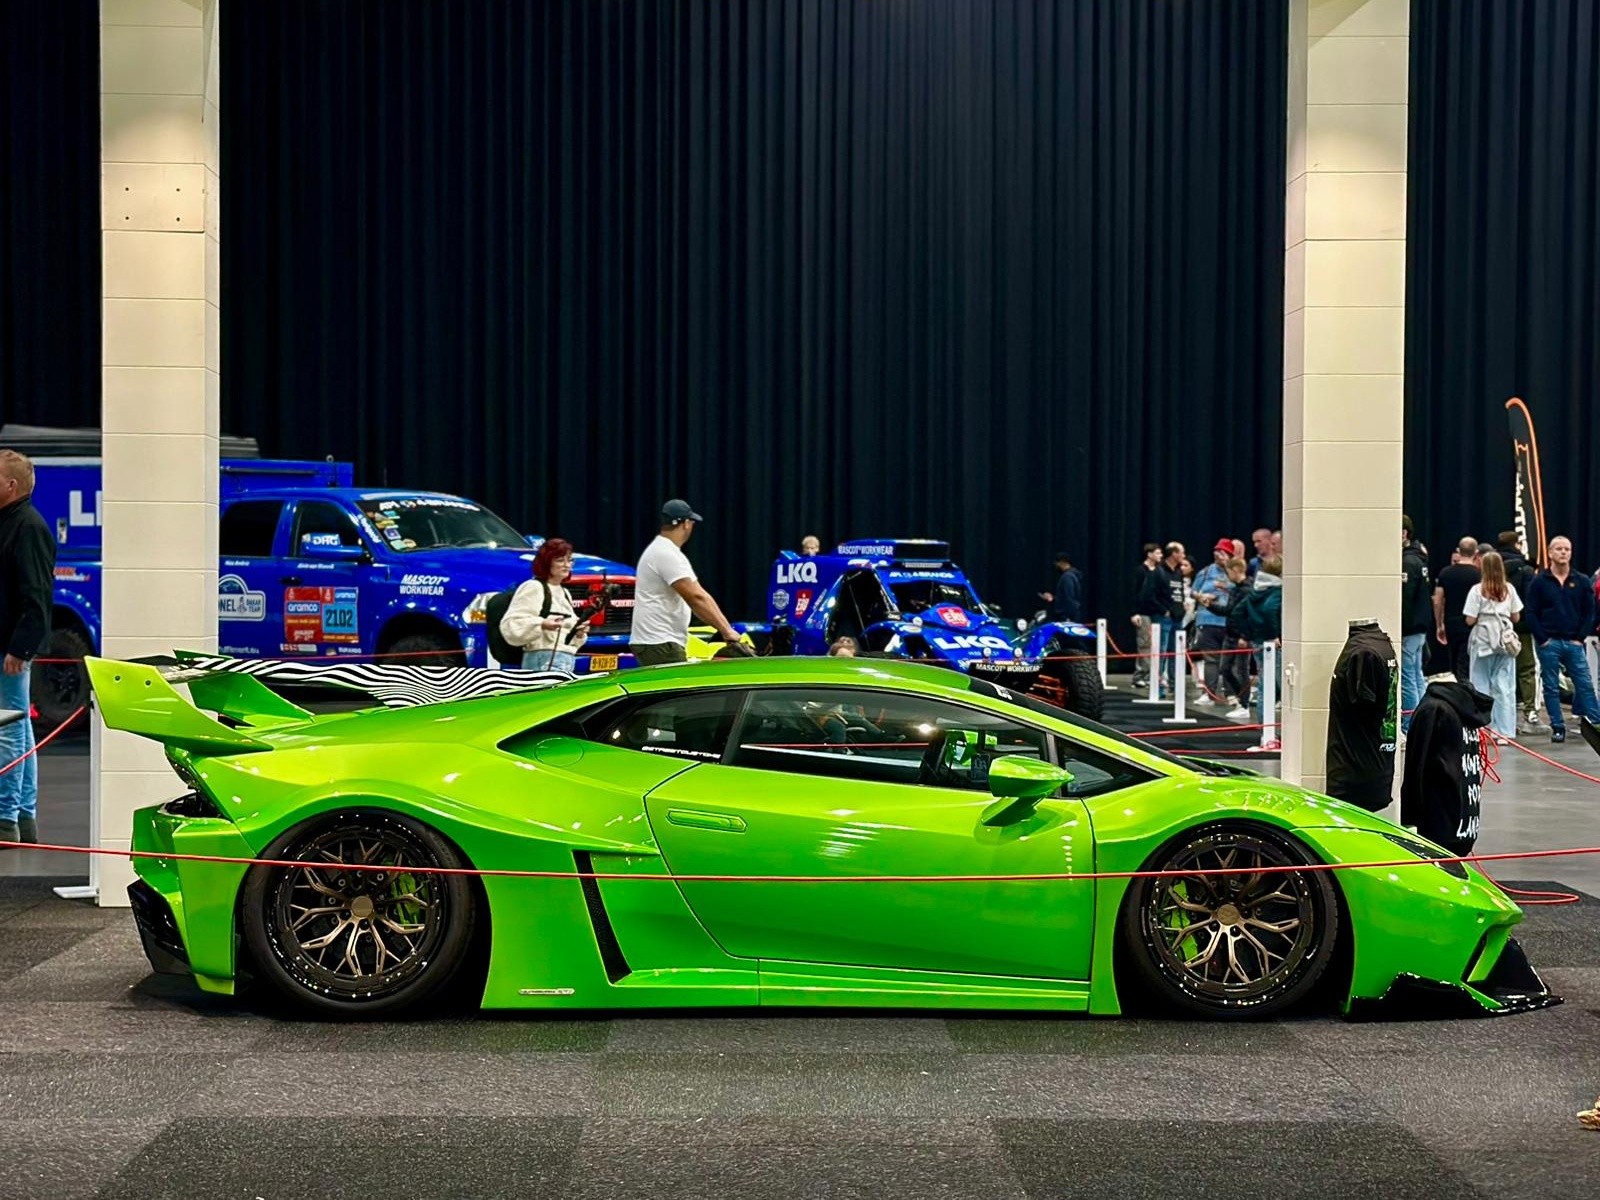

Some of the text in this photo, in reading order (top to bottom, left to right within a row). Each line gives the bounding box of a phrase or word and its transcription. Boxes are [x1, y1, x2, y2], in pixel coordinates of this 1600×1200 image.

[69, 490, 102, 526] L
[777, 561, 818, 584] LKQ
[401, 574, 443, 585] MASCOT
[399, 585, 445, 596] WORKWEAR
[288, 603, 318, 612] aramco
[325, 609, 354, 628] 2102
[933, 635, 1014, 650] LKQ
[975, 663, 1041, 673] MASCOT WORKWEAR
